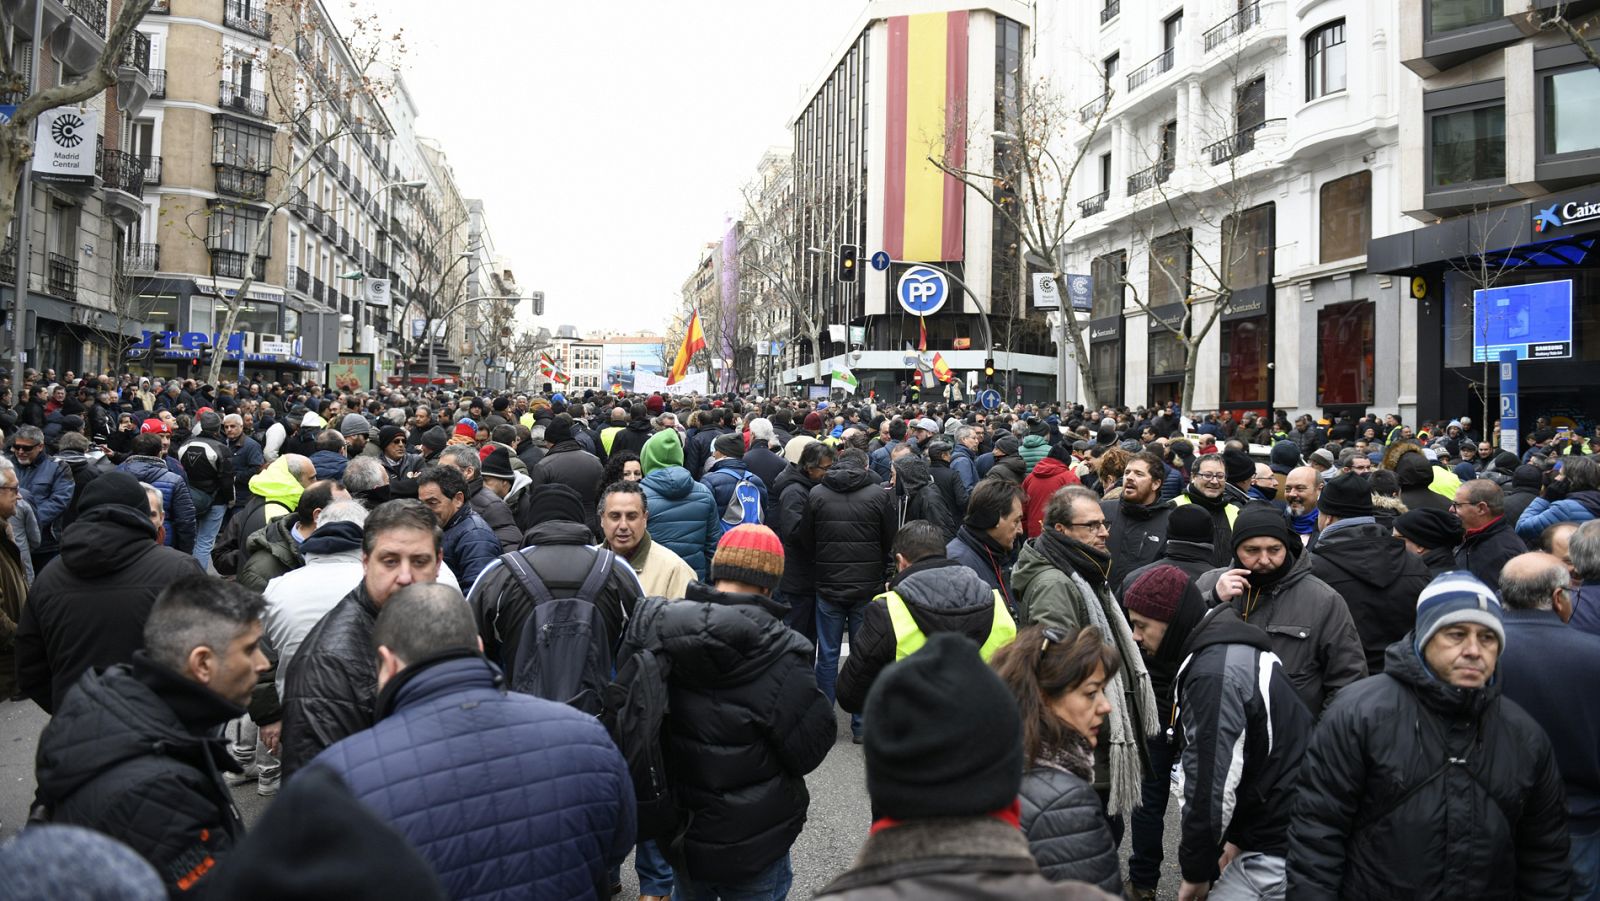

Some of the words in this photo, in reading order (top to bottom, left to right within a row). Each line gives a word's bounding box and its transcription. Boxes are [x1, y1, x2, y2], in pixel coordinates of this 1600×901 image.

[54, 152, 80, 160] Madrid
[52, 160, 80, 168] Central
[909, 282, 937, 303] PP
[1232, 300, 1262, 313] Santander
[1097, 328, 1116, 337] Santander
[1501, 396, 1510, 417] P
